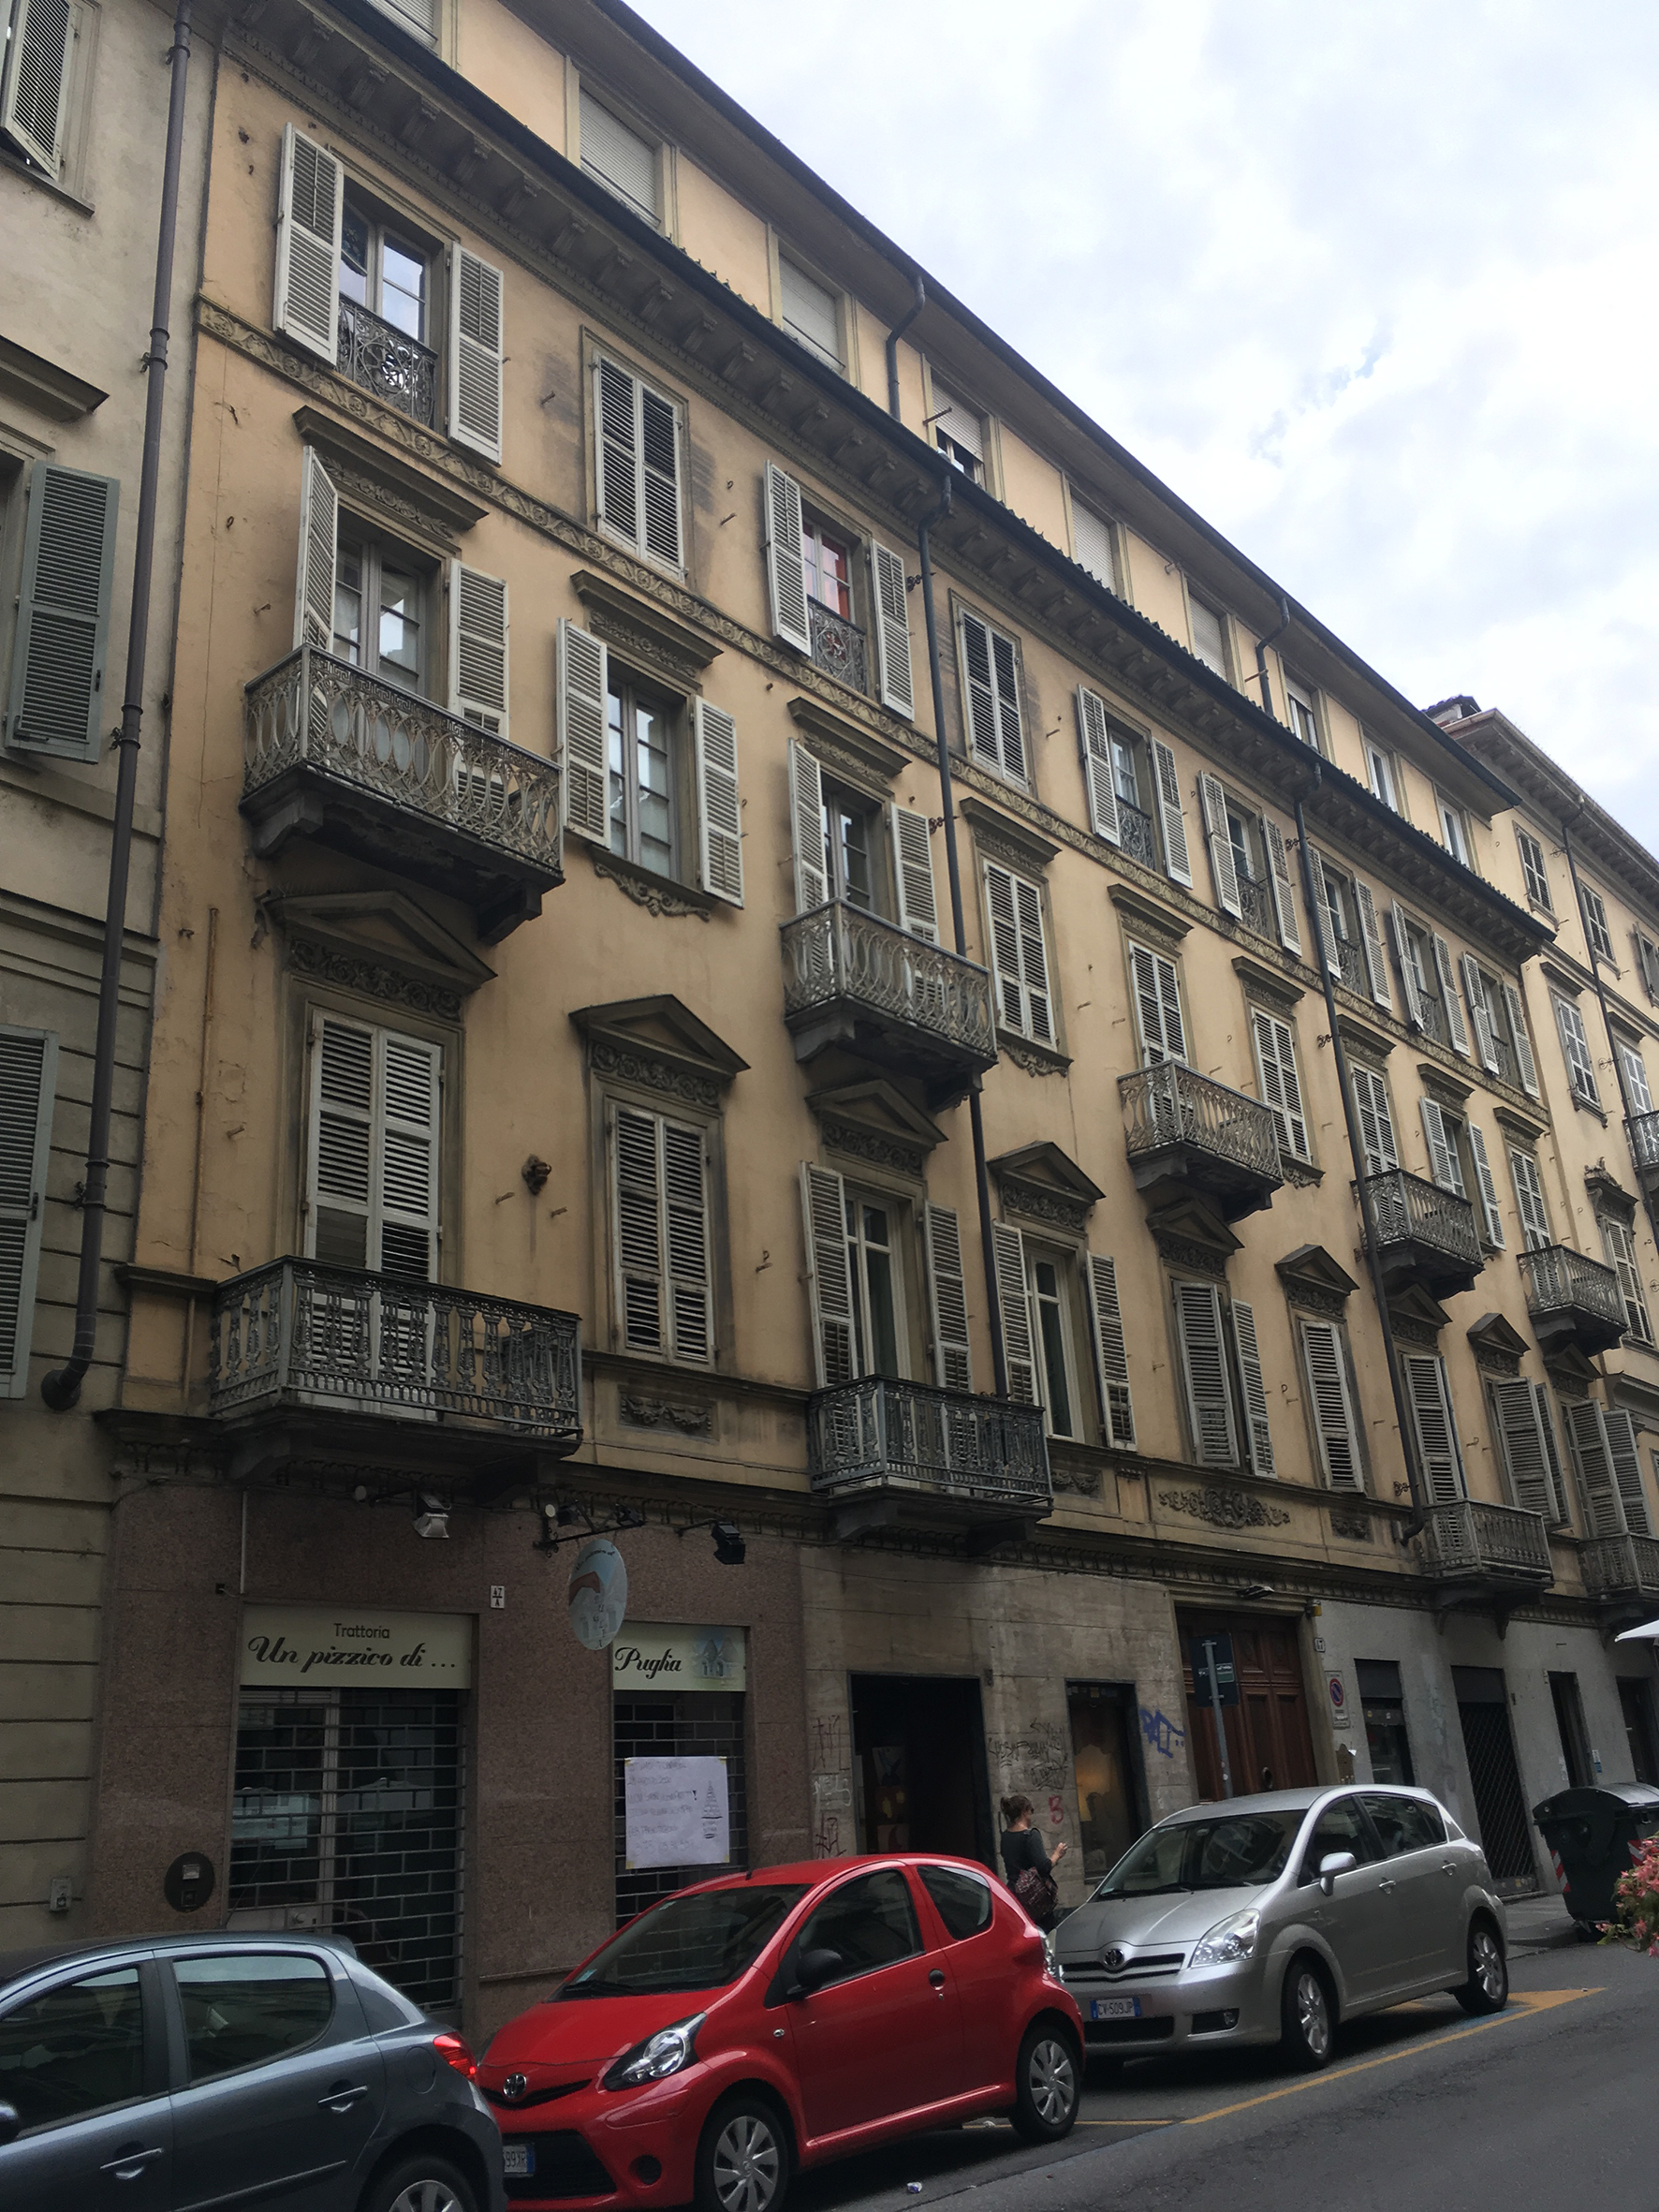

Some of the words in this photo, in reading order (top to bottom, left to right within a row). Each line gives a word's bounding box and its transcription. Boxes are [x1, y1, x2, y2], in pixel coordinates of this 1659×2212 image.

[492, 1587, 503, 1596] 47
[334, 1623, 390, 1639] Trattoria
[247, 1636, 299, 1663] Un
[300, 1645, 393, 1674] pizzico
[614, 1646, 683, 1680] Puglia
[504, 2151, 526, 2168] 99XR
